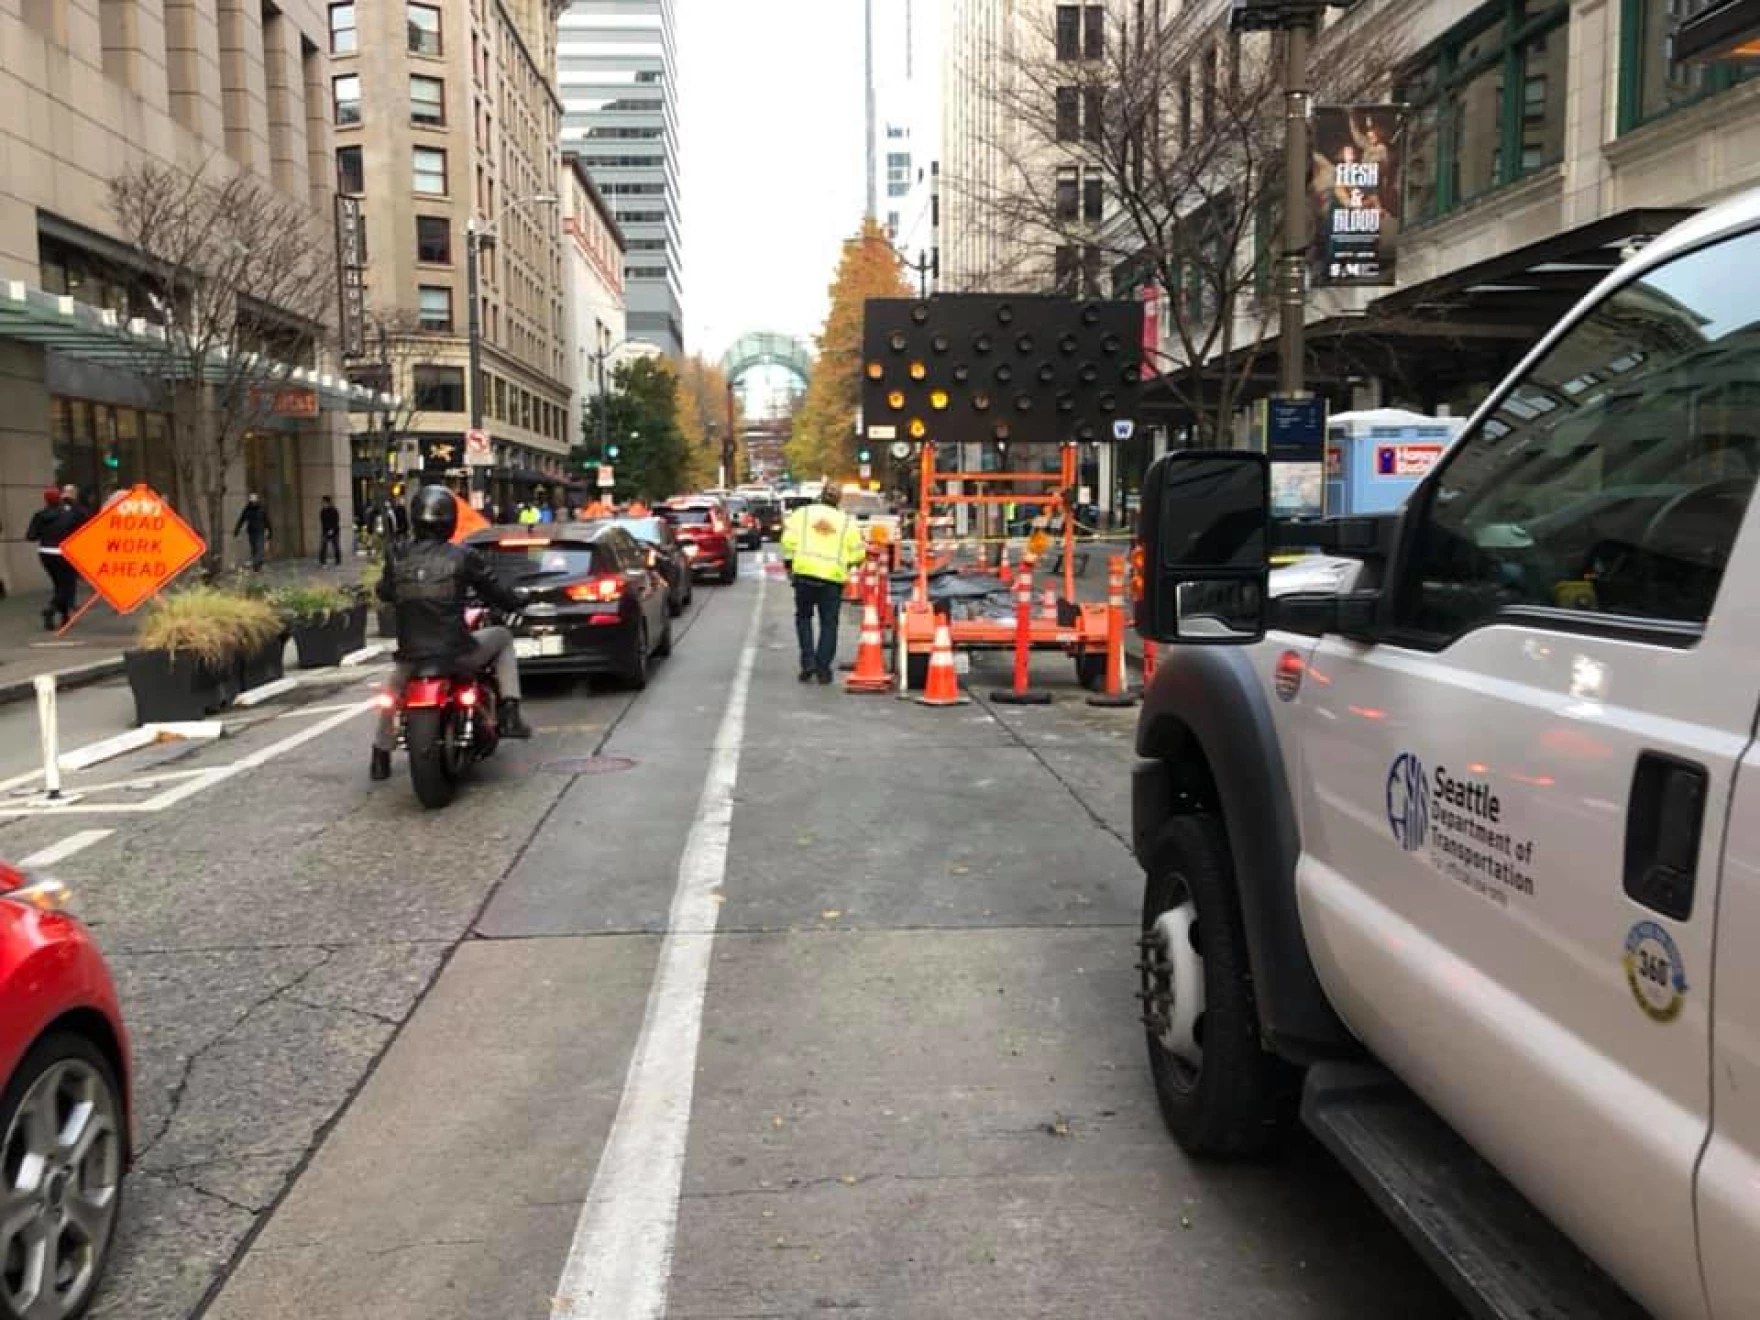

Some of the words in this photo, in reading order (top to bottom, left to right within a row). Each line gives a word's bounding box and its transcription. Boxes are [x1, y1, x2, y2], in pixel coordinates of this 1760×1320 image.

[1335, 162, 1379, 186] FLESH
[1350, 188, 1364, 206] &
[1333, 208, 1380, 232] BLOOD
[110, 515, 164, 530] ROAD
[107, 538, 161, 553] WORK
[98, 561, 167, 577] AHEAD
[1433, 765, 1500, 823] Seattle
[1432, 800, 1511, 856] Department
[1515, 841, 1533, 865] of
[1431, 824, 1534, 896] Transportation
